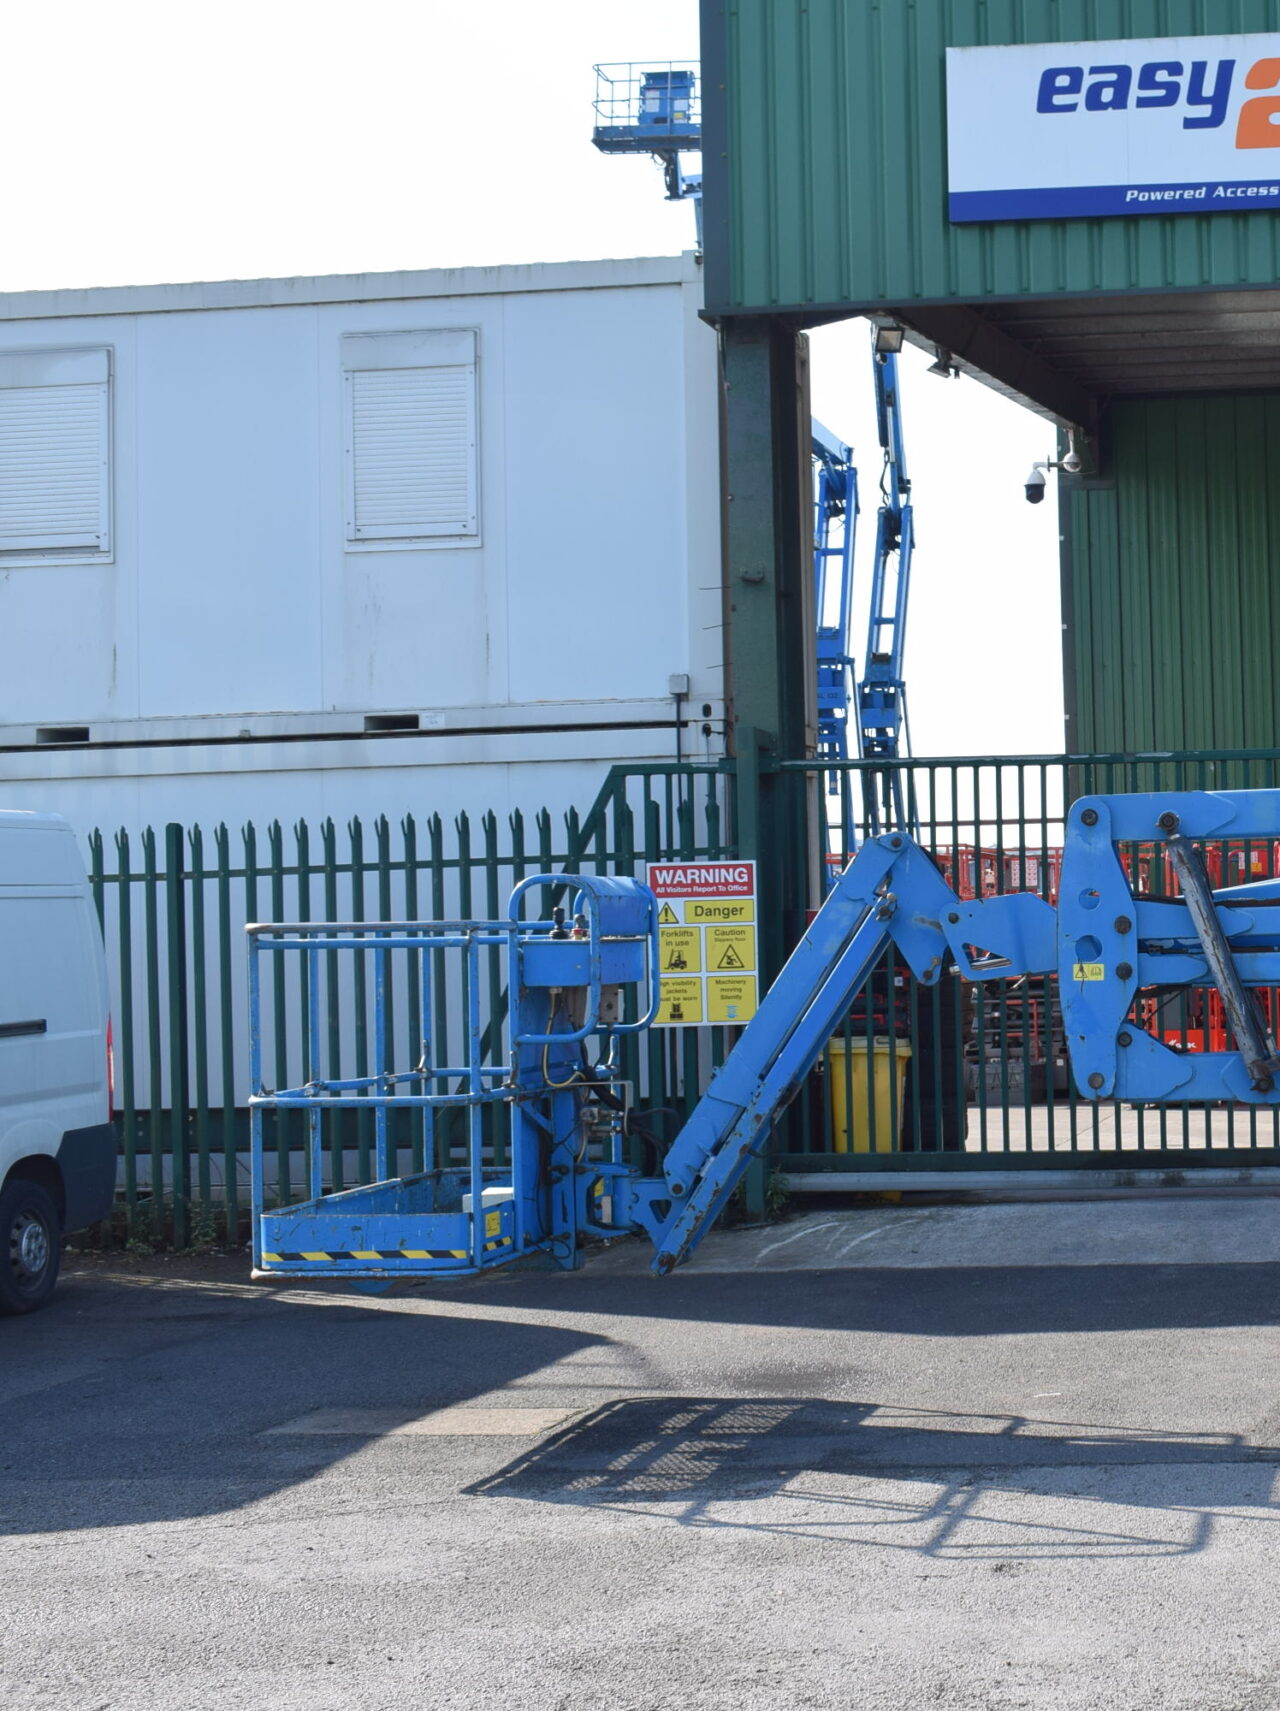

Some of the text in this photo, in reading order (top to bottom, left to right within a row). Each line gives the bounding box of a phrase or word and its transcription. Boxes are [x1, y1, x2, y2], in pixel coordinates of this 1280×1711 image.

[1125, 184, 1206, 203] Powered
[1213, 181, 1279, 198] Access
[655, 867, 748, 885] WARNING
[693, 886, 716, 894] Report
[694, 905, 744, 919] Danger
[661, 930, 694, 938] Forklifts
